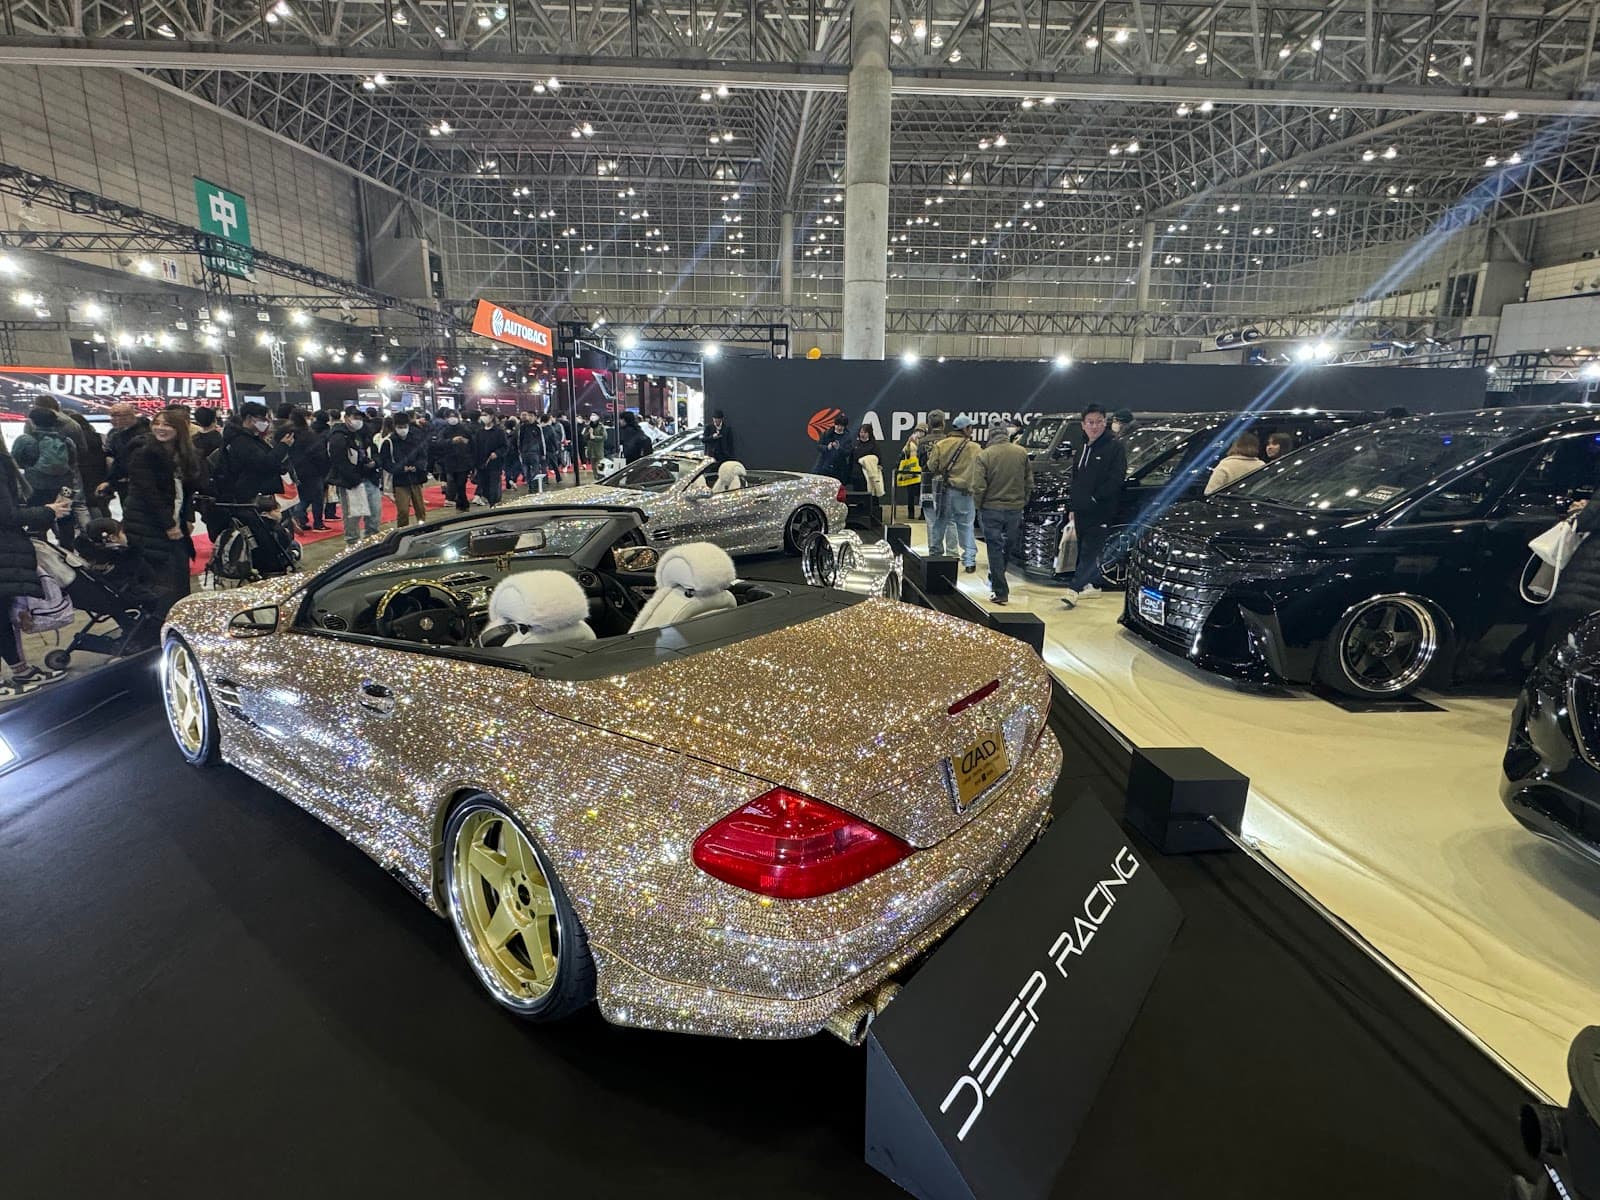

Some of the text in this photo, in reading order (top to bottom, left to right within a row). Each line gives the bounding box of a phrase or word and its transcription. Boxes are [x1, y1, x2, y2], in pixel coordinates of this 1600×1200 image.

[208, 191, 238, 237] 中
[503, 319, 548, 347] AUTOBACS
[50, 374, 159, 397] URBAN
[167, 377, 222, 398] LIFE
[939, 846, 1141, 1142] DEEP RACING
